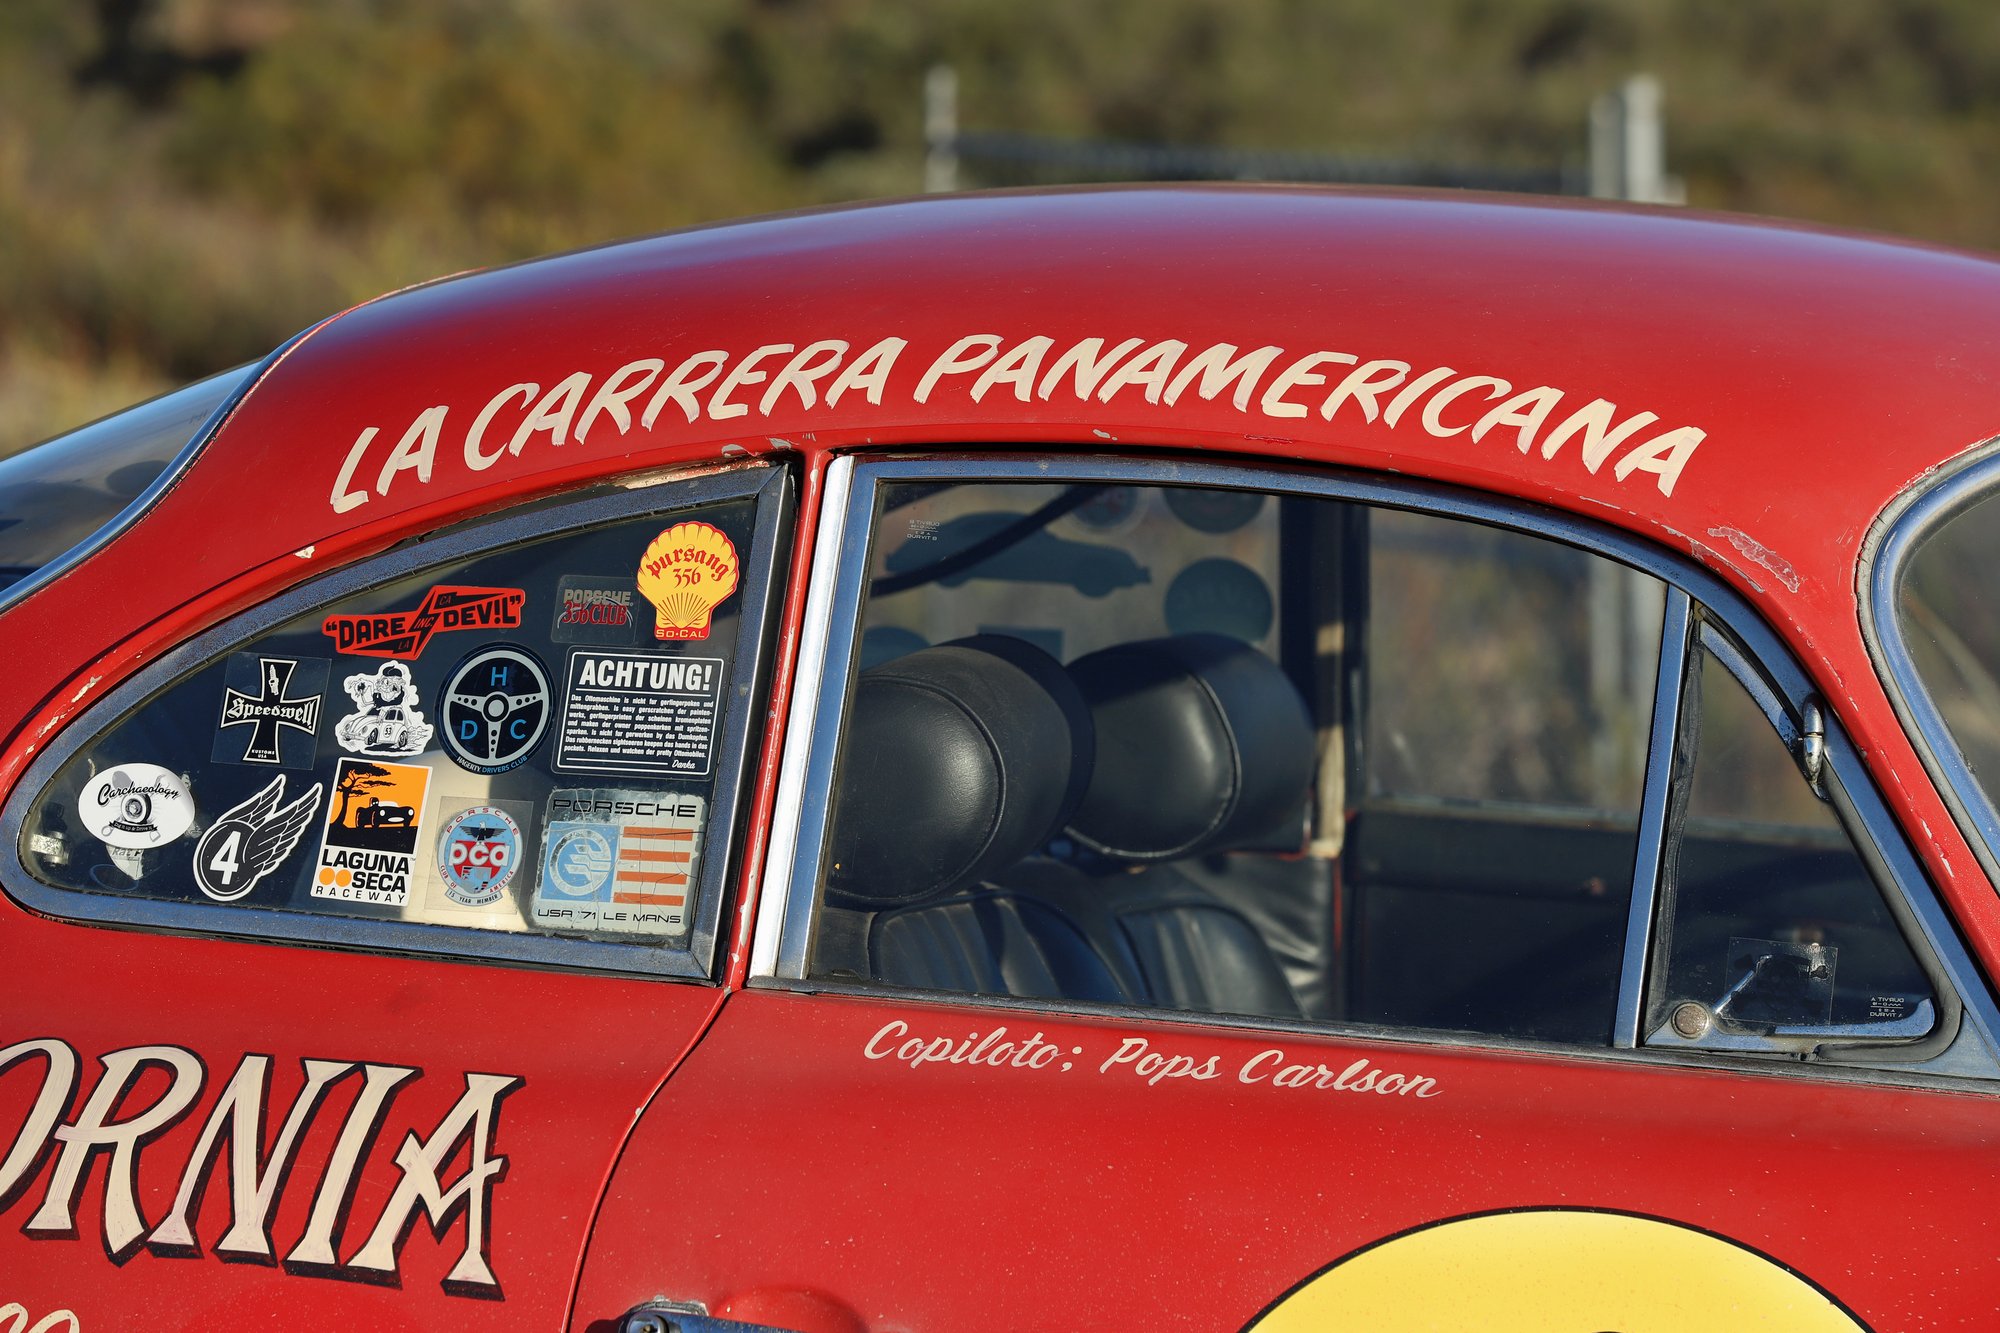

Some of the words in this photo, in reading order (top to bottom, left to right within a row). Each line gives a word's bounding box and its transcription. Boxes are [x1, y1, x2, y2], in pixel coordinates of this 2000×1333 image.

[330, 404, 449, 513] LA
[463, 336, 908, 471] CARRERA
[913, 334, 1709, 498] PANAMERICANA
[646, 544, 729, 581] pursang
[673, 567, 702, 588] 356
[439, 593, 452, 605] CA
[415, 616, 434, 630] INC.
[490, 666, 508, 686] H
[578, 659, 713, 691] ACHTUNG!
[385, 727, 392, 736] 53
[460, 720, 478, 740] D
[510, 719, 527, 740] C
[656, 732, 663, 740] by
[457, 756, 481, 772] HAGERTY
[482, 764, 510, 773] DRIVERS
[511, 756, 528, 768] CLUB
[98, 781, 180, 806] Carchaeology
[552, 800, 697, 818] PORSCHE
[447, 808, 519, 835] PORSCHE
[209, 830, 242, 886] 4
[321, 849, 410, 875] LAGUNA
[448, 842, 511, 867] pca
[352, 871, 406, 894] SECA
[440, 865, 448, 879] CLUB
[489, 870, 514, 893] AMERICA
[315, 886, 406, 904] RACEWAY
[477, 894, 498, 904] MEMBER
[538, 908, 572, 918] USA
[603, 912, 627, 921] LE
[632, 913, 681, 924] MANS
[1099, 1037, 1221, 1087] Pops
[1238, 1049, 1445, 1098] Carlson
